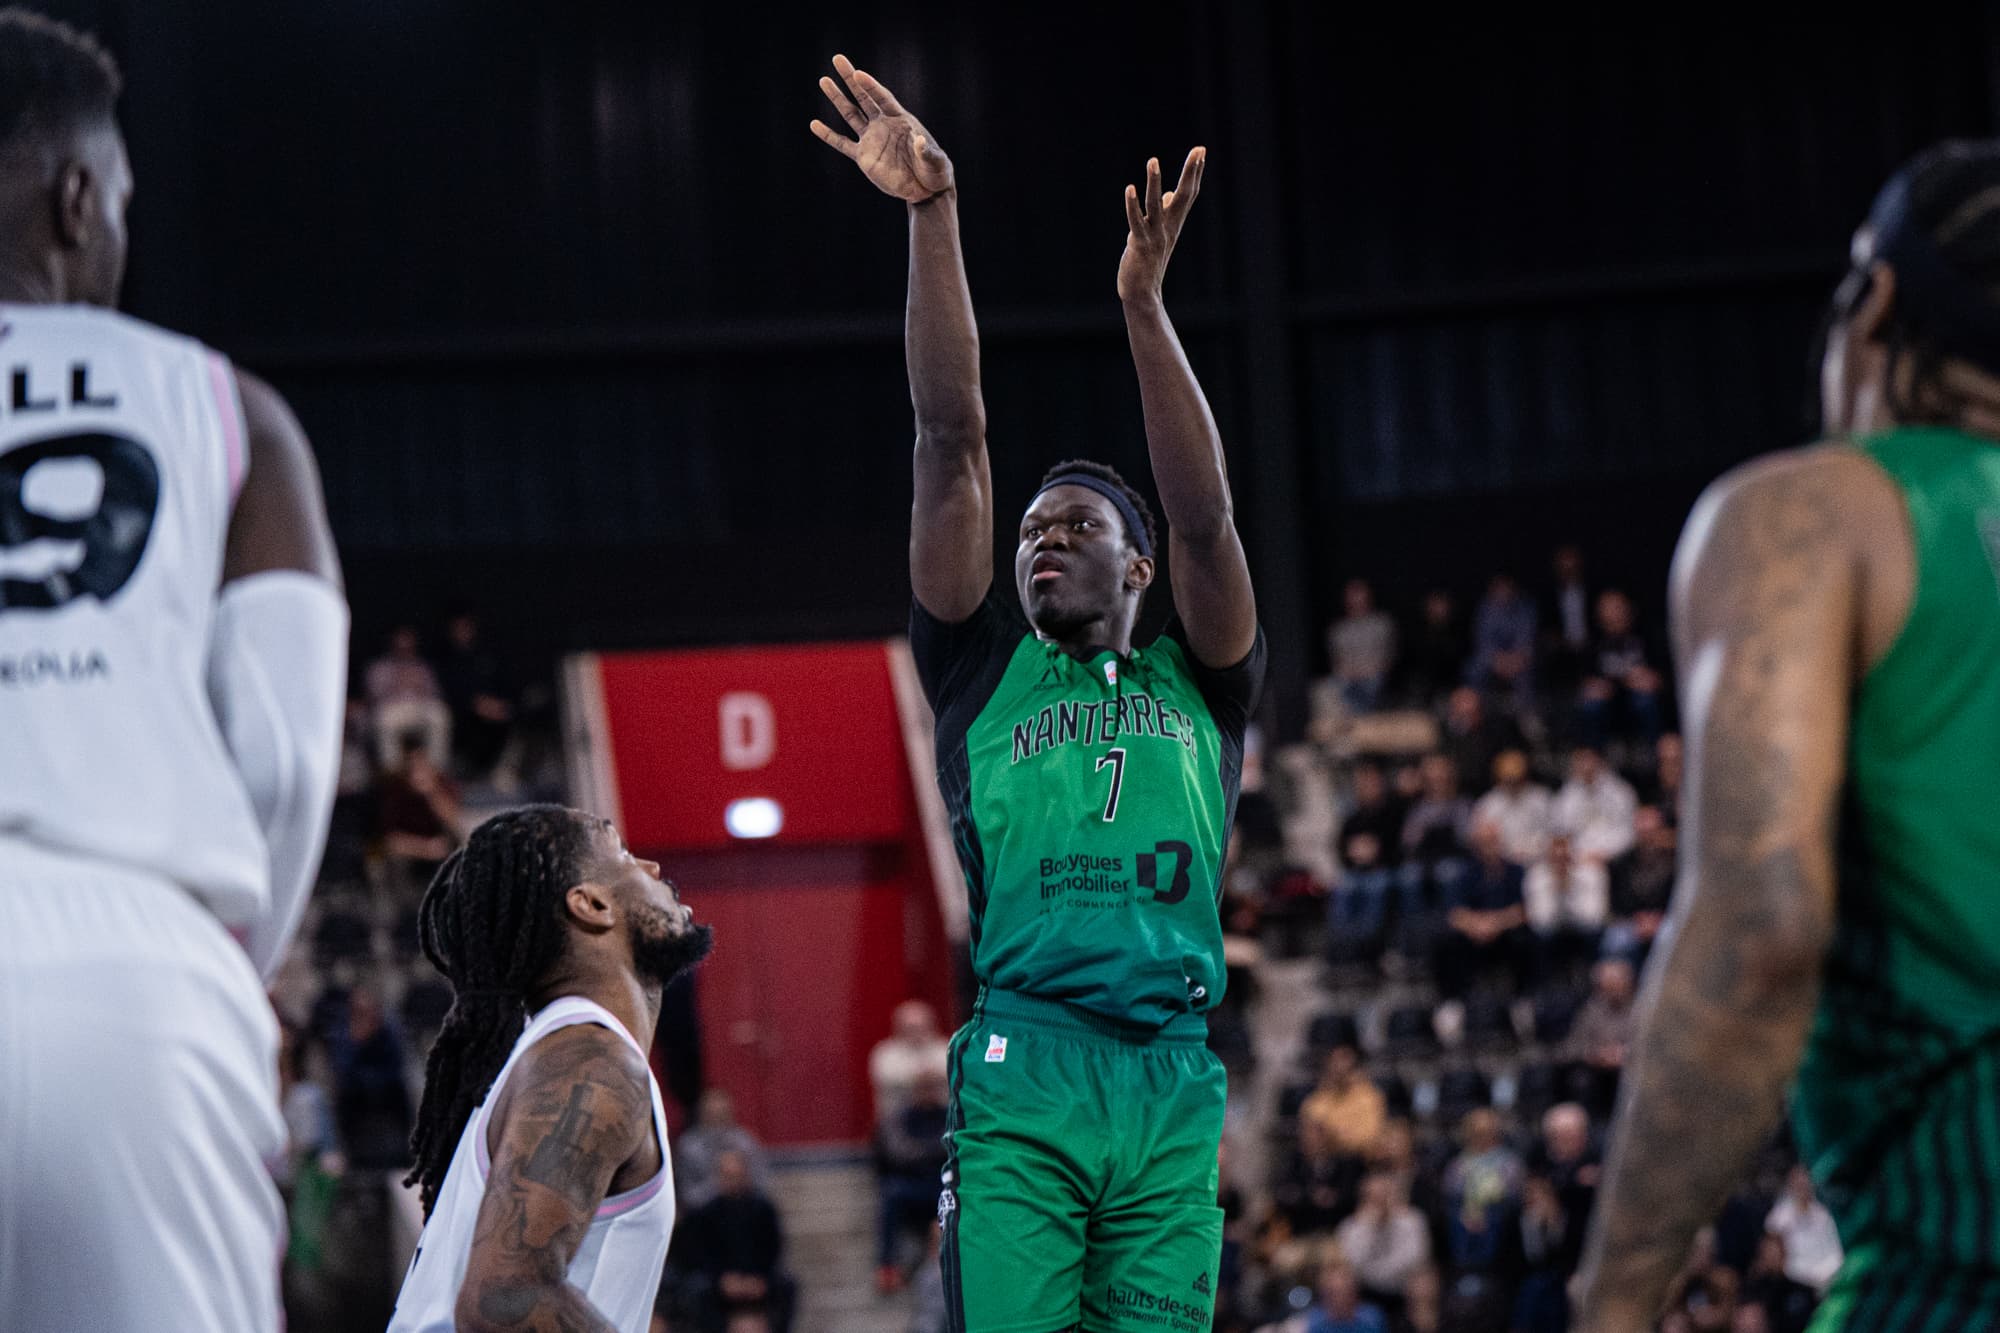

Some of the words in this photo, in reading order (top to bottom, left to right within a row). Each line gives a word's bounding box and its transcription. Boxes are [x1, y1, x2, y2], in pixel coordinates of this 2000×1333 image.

[0, 363, 118, 412] LL
[718, 691, 777, 770] D
[1095, 747, 1126, 822] 7
[1039, 853, 1123, 878] Bouygues
[1040, 873, 1130, 900] Immobilier
